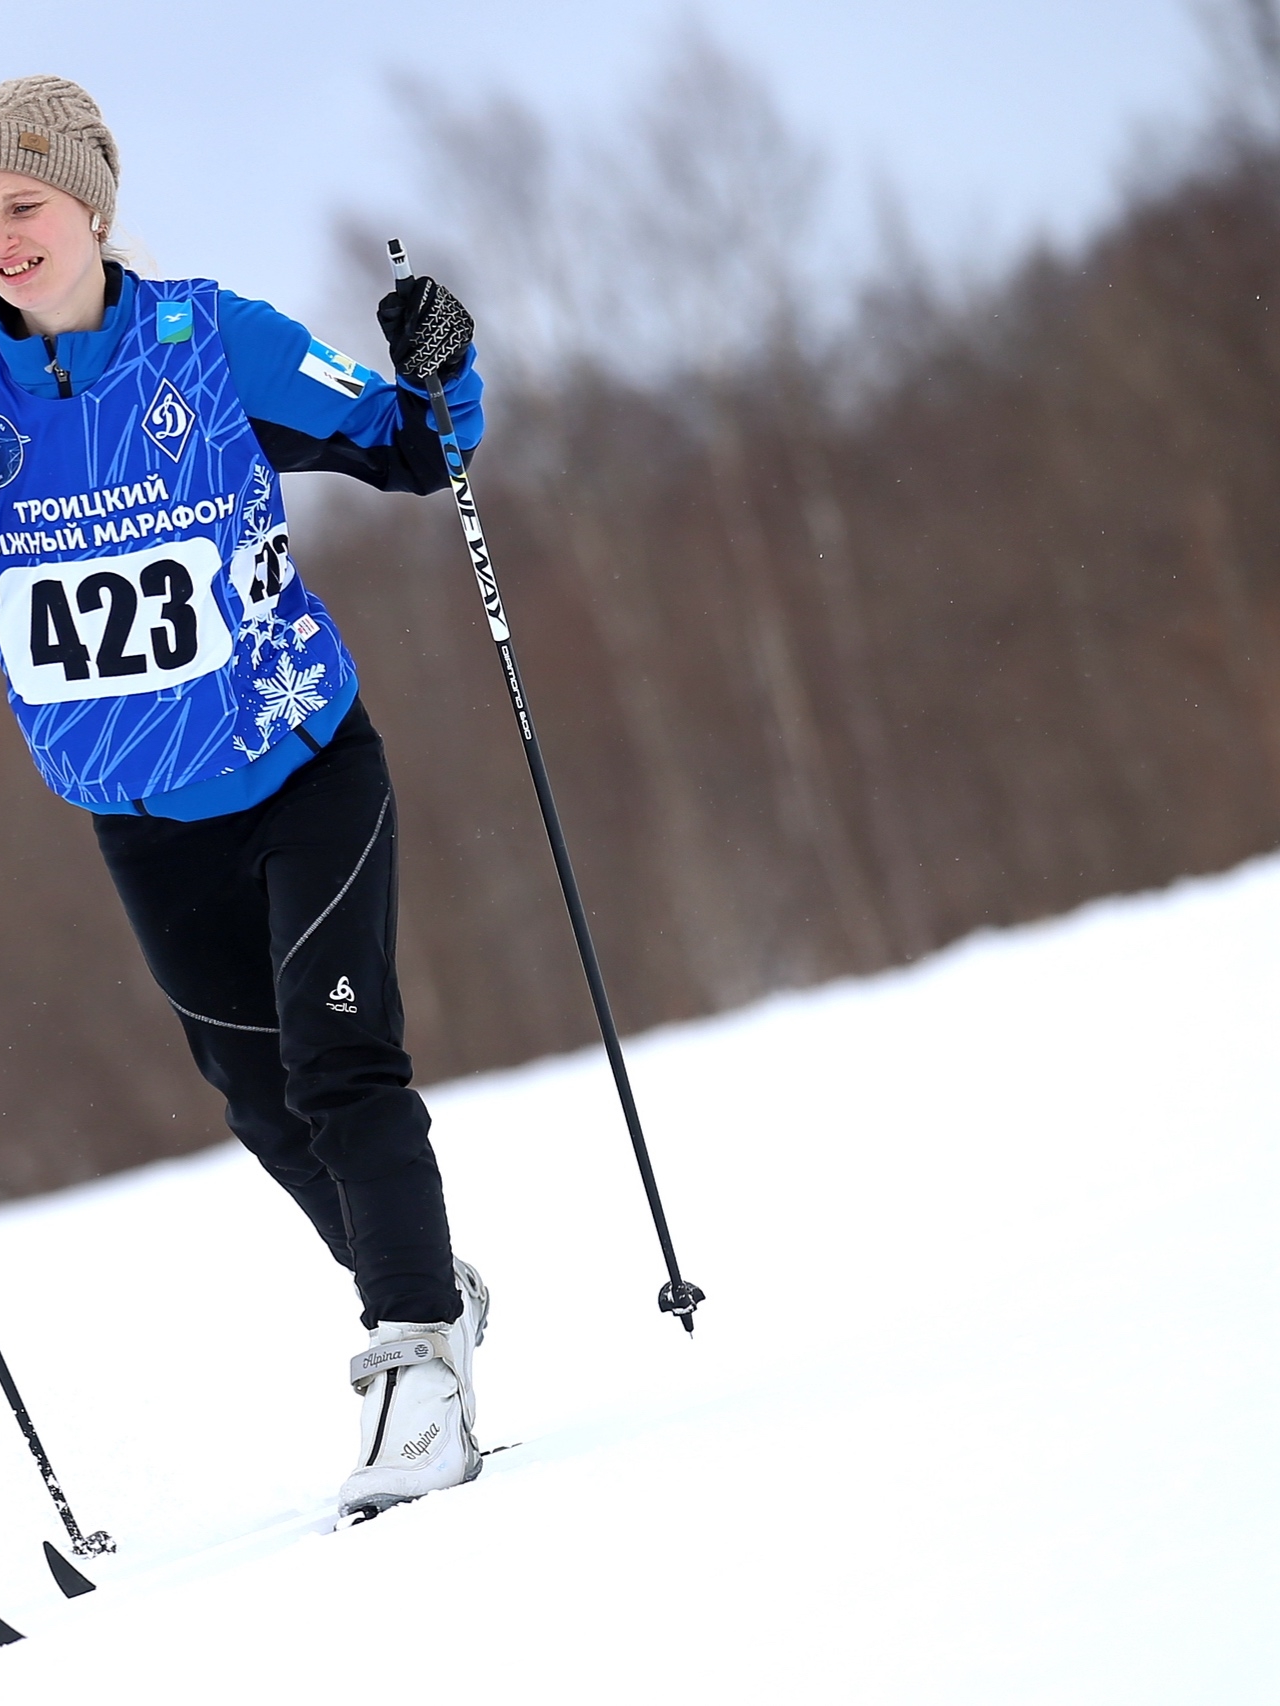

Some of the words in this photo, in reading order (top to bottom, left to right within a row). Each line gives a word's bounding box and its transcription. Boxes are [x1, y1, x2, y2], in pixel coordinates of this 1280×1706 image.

[13, 473, 169, 524] ТРОИЦКИЙ
[93, 493, 235, 547] МАРАФОН
[30, 559, 198, 682] 423
[362, 1350, 404, 1369] Alpina
[401, 1422, 441, 1460] Alpina
